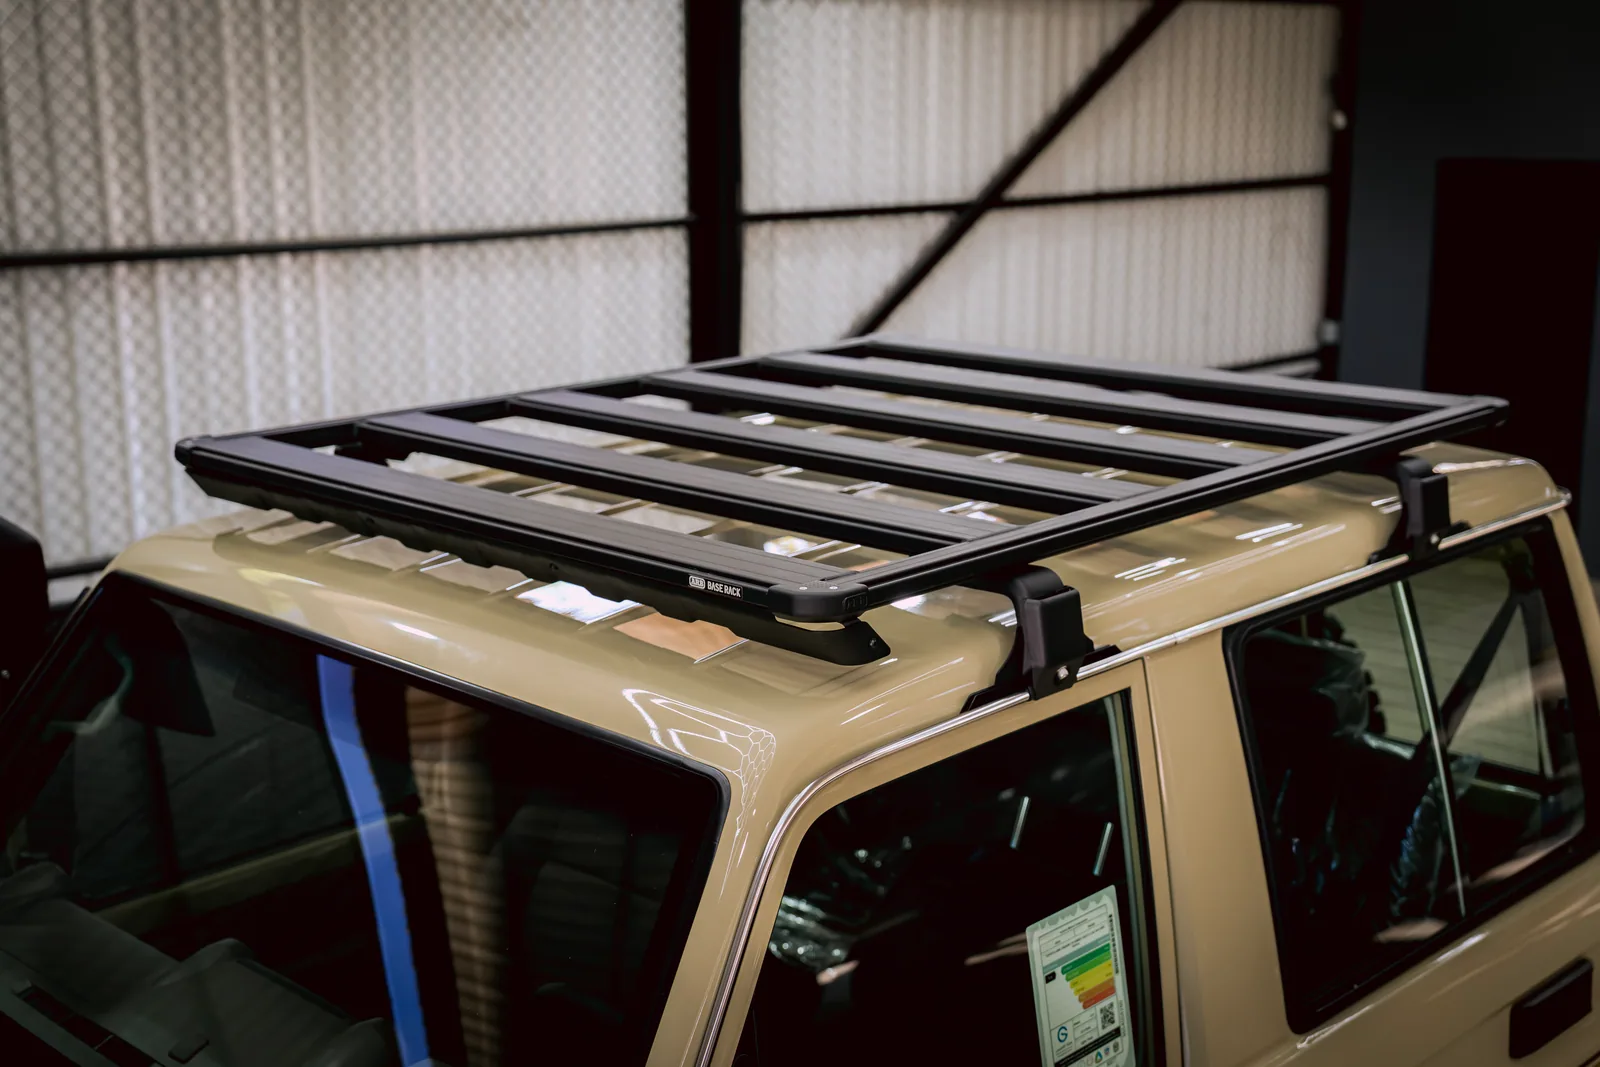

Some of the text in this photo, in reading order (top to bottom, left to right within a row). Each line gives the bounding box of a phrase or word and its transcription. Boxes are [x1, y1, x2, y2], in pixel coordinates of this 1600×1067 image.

[690, 577, 741, 598] ARB BASE RACK
